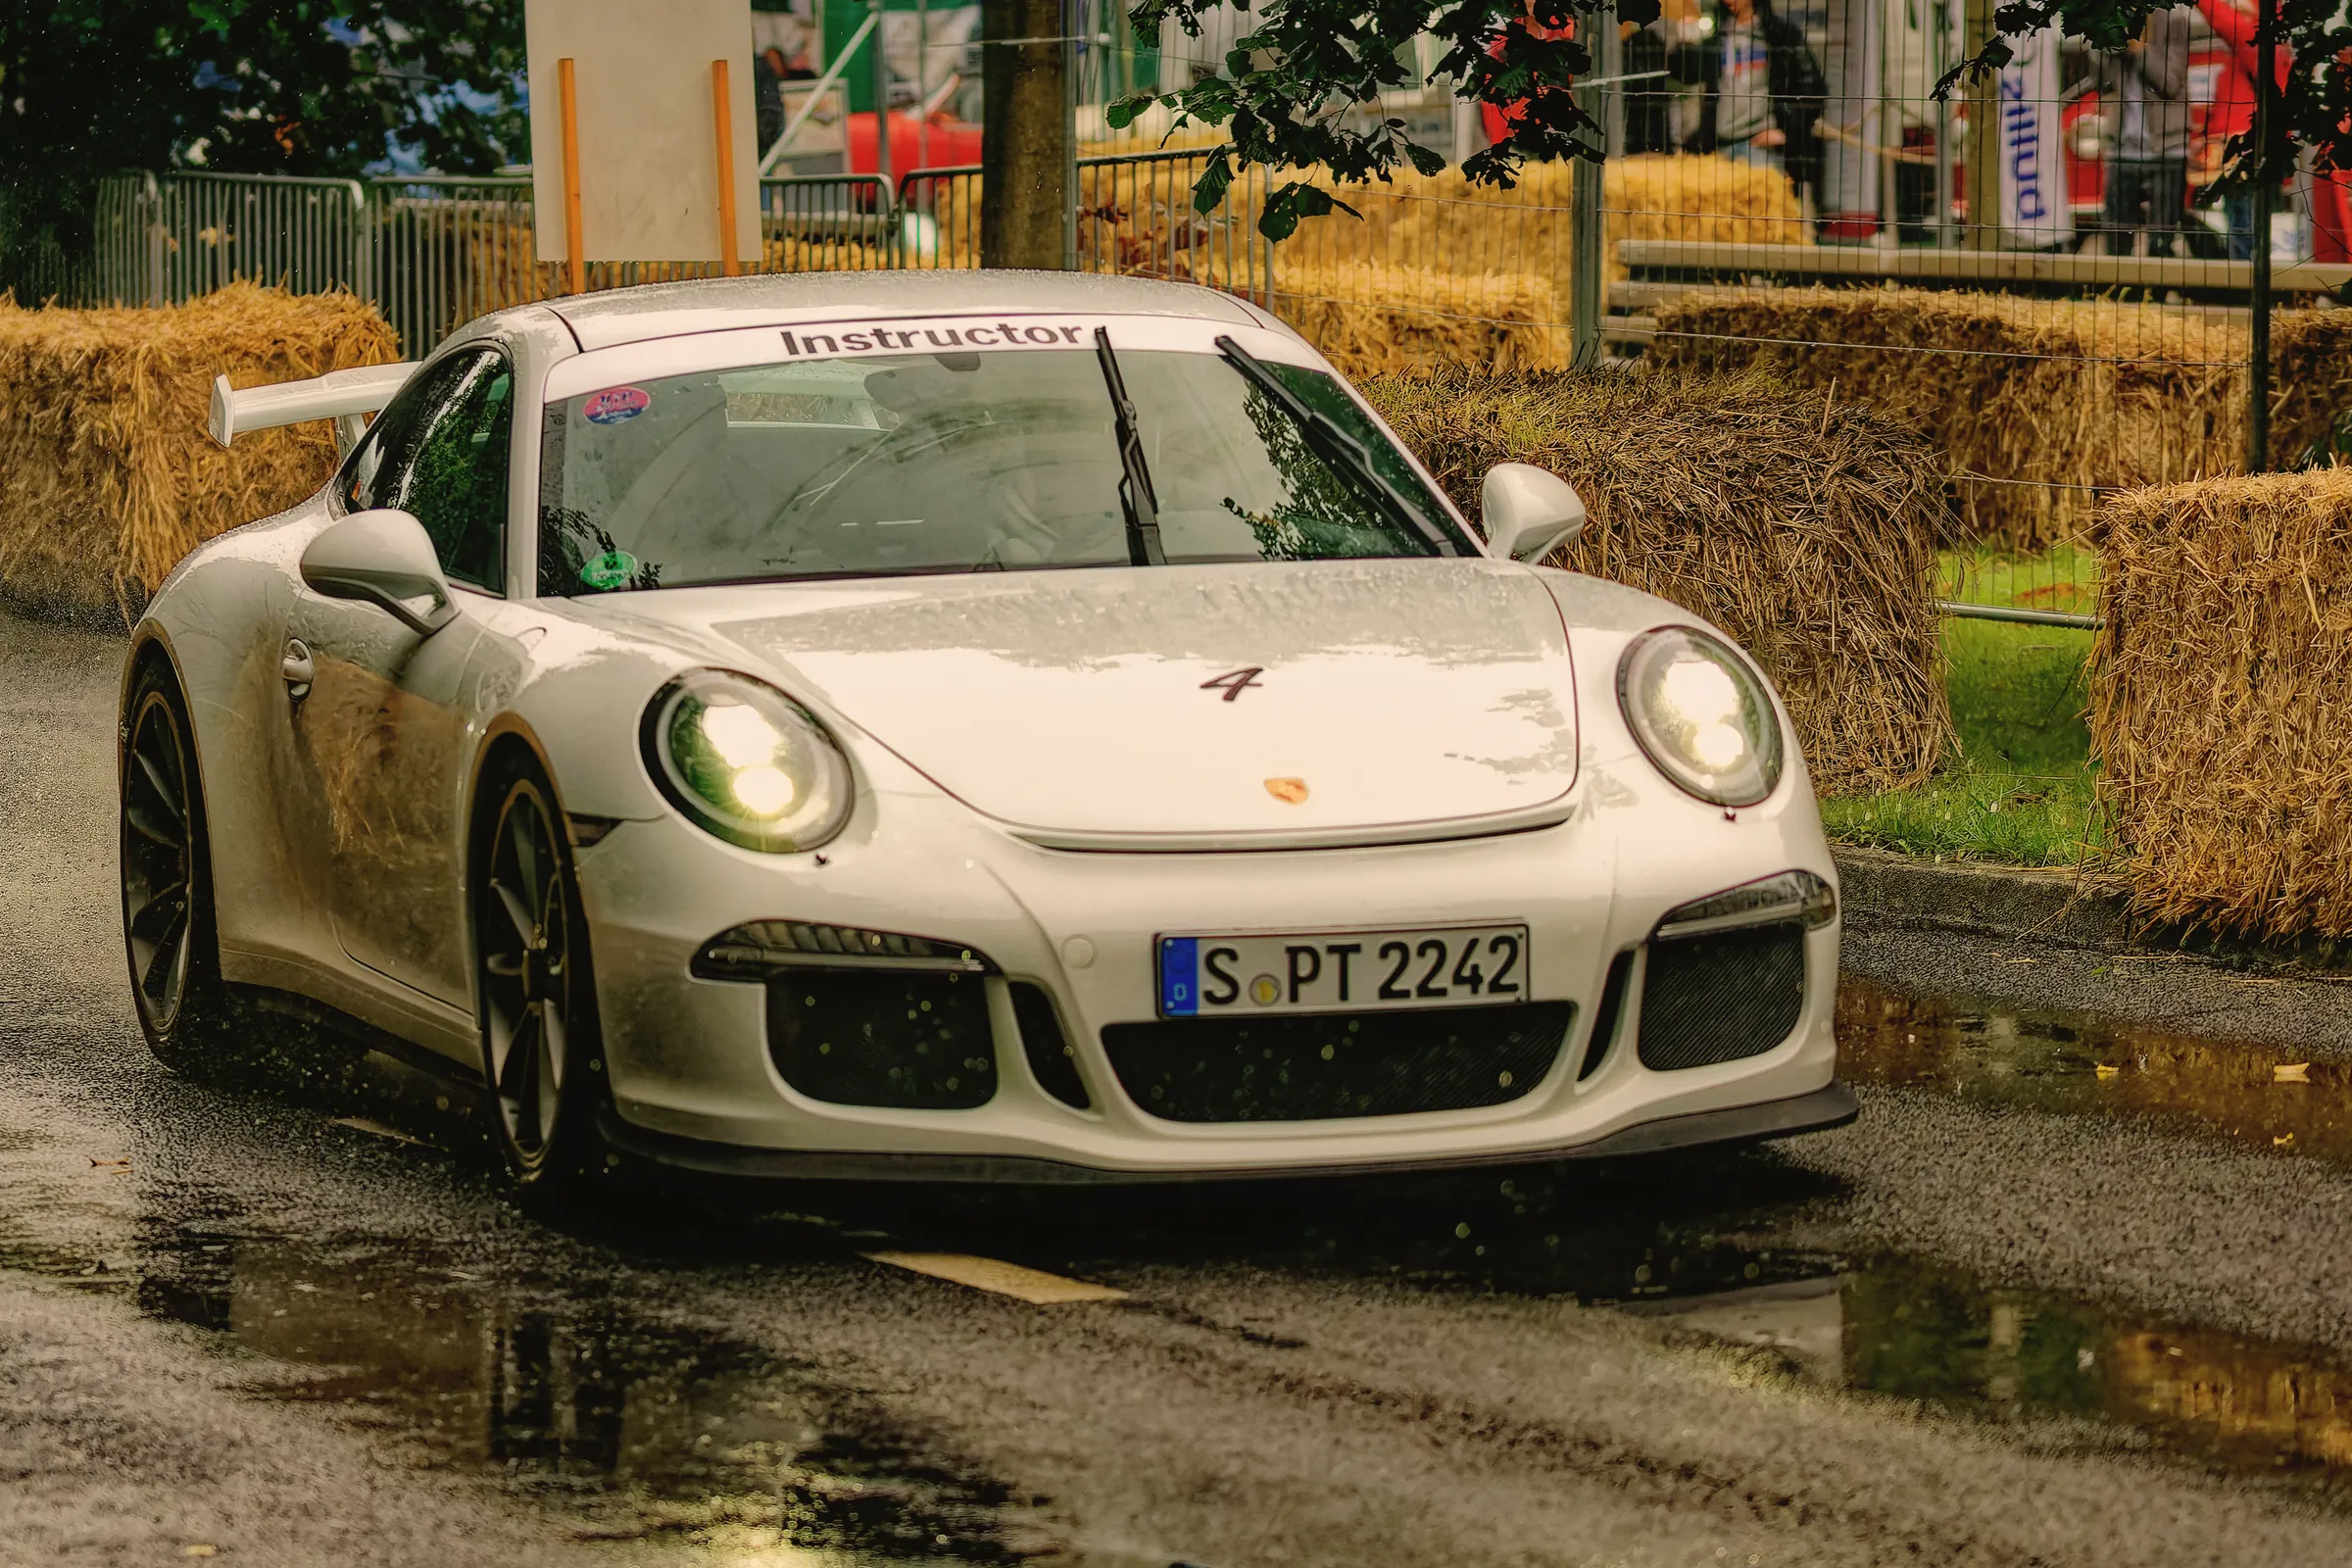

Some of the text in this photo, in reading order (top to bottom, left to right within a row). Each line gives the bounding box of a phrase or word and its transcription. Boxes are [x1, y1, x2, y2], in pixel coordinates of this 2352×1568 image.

[780, 322, 1083, 356] Instructor
[1200, 667, 1263, 702] 4
[1202, 947, 1240, 1005] S
[1284, 943, 1361, 1004] PT
[1378, 935, 1519, 1000] 2242
